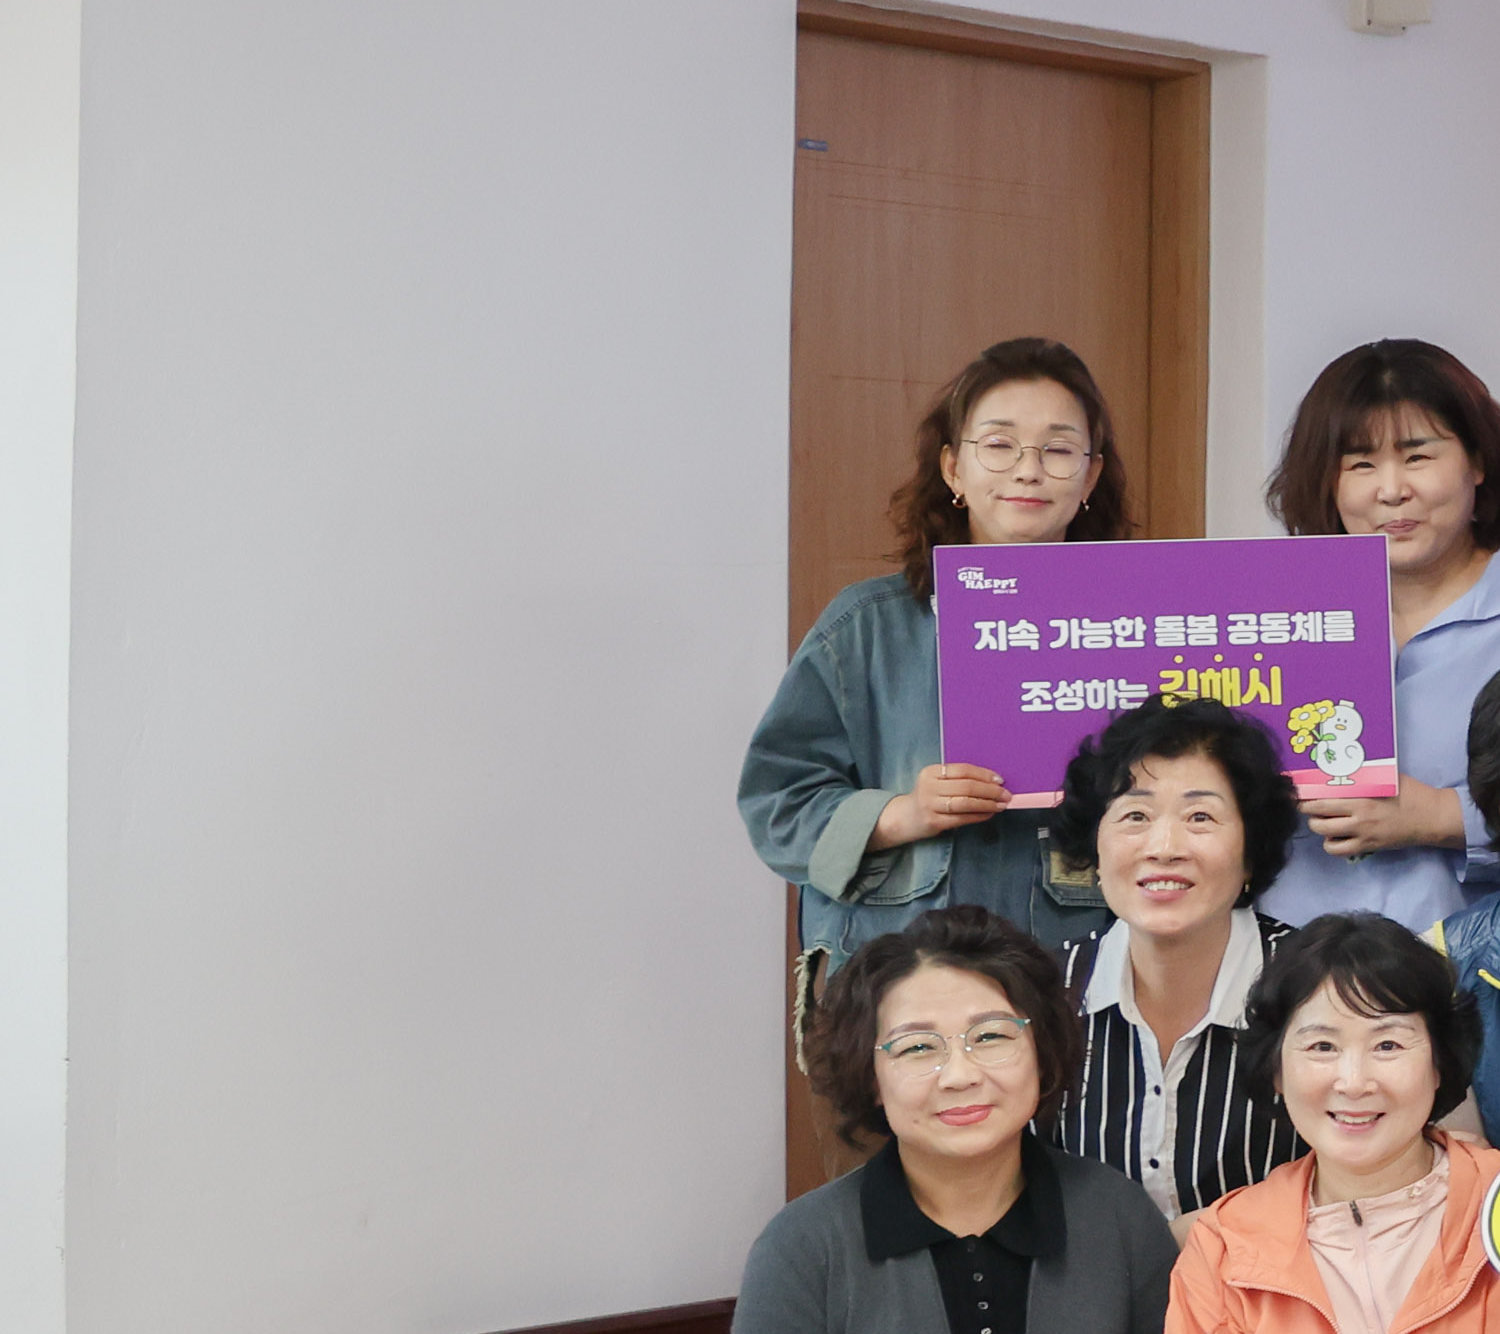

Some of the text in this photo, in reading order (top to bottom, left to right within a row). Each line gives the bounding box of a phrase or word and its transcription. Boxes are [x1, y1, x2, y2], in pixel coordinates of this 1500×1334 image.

[957, 571, 984, 582] GIM
[973, 611, 1355, 652] 지속 가능한 돌봄 공동체를
[1021, 679, 1149, 713] 조성하는
